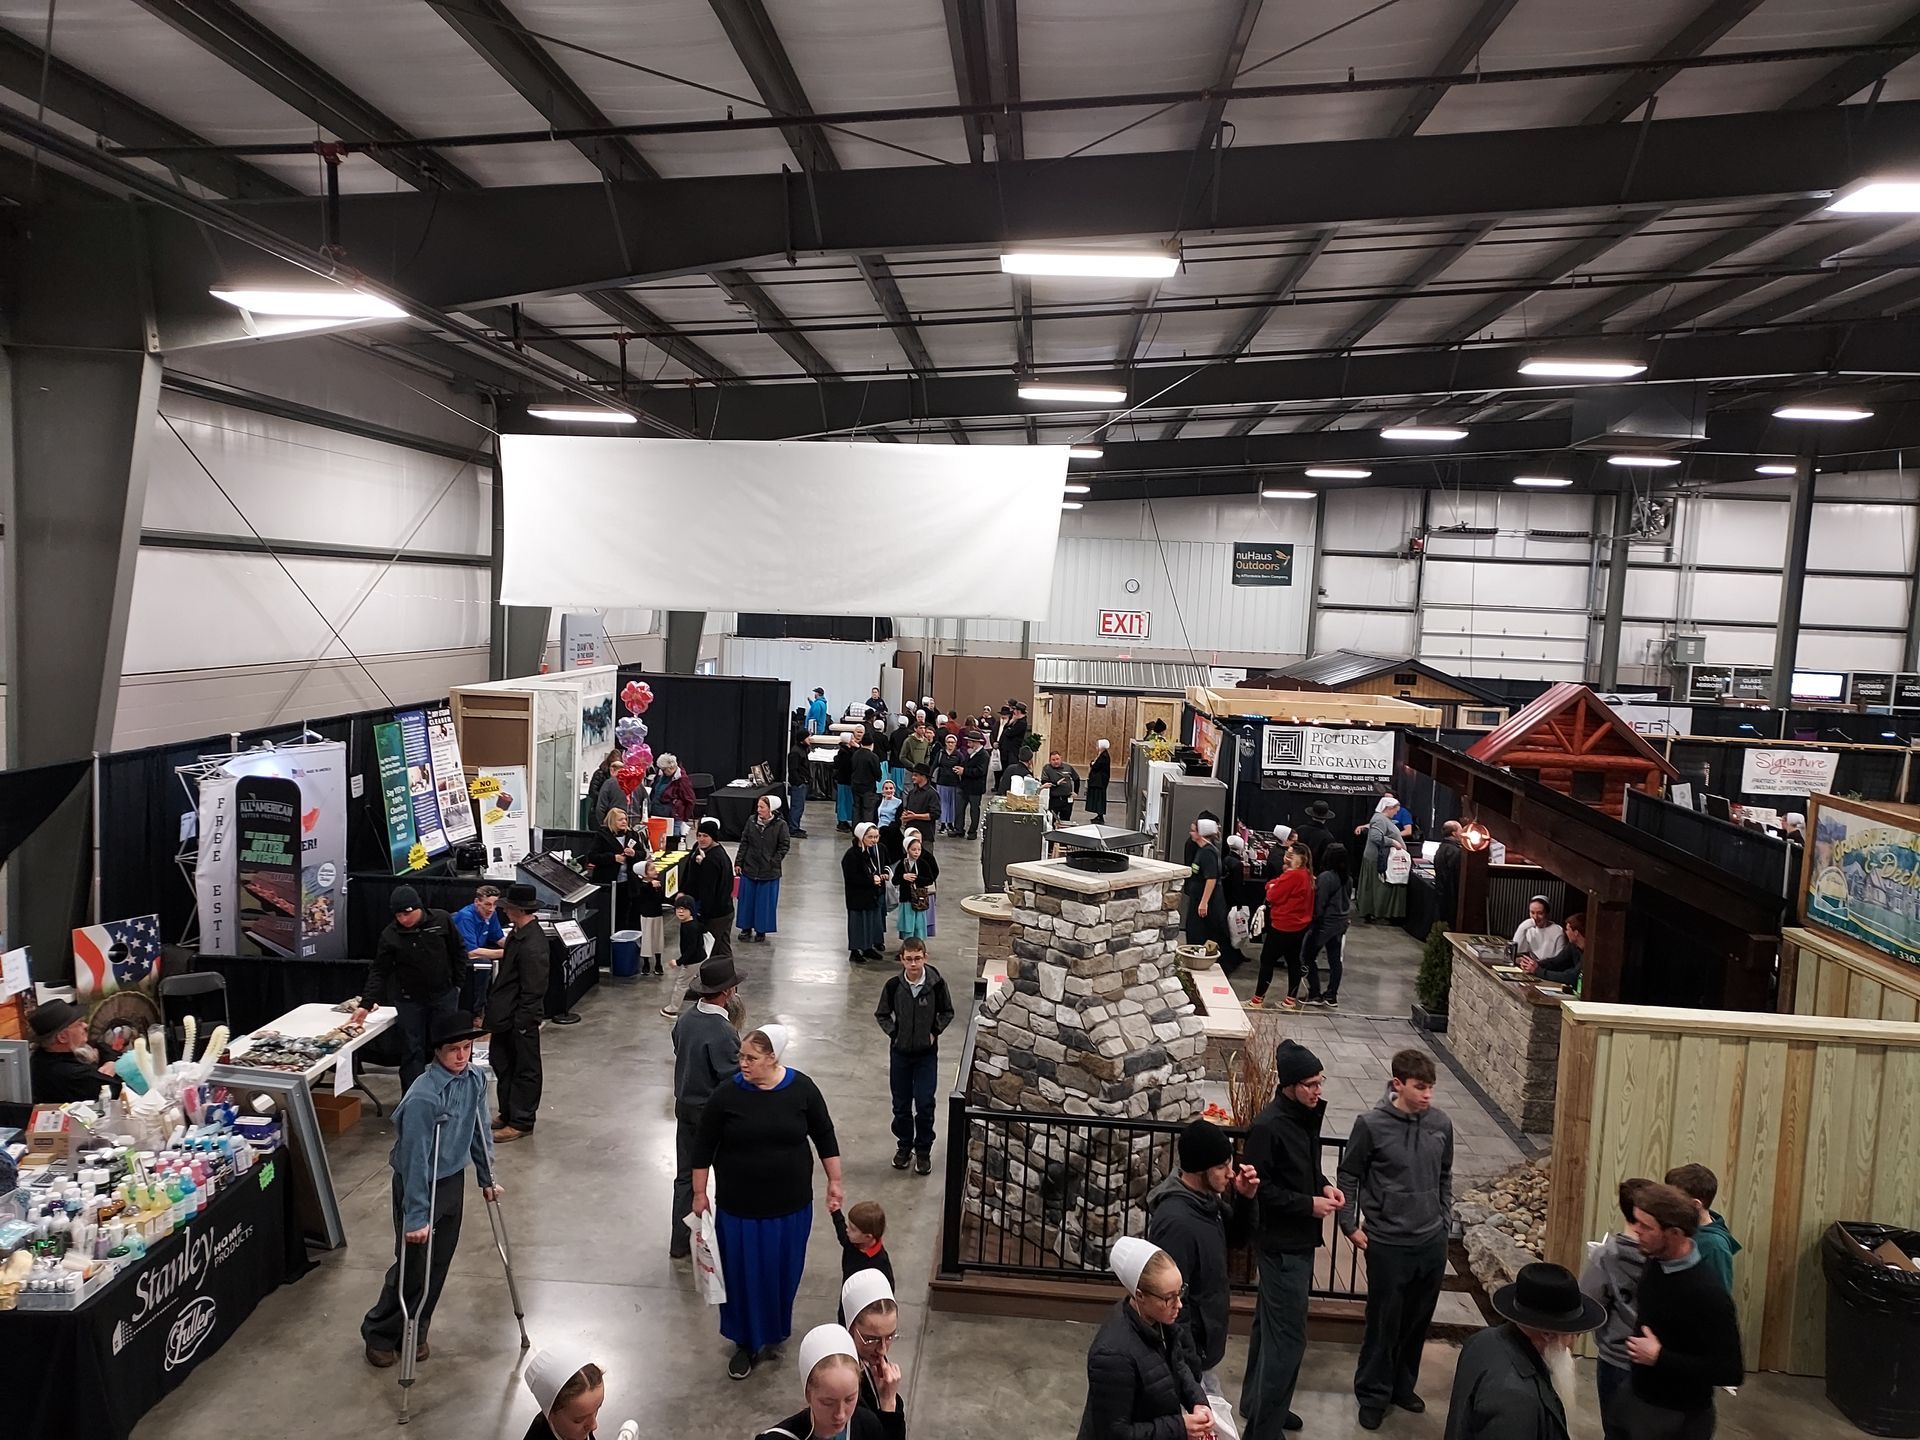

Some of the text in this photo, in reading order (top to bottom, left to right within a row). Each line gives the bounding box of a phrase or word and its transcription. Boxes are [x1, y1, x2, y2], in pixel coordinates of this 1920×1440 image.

[1236, 551, 1273, 560] nuHaus
[1235, 561, 1280, 570] Outdoors
[1102, 613, 1144, 634] EXIT
[1311, 744, 1323, 754] IT
[1309, 756, 1387, 770] ENGRAVING
[1755, 752, 1827, 776] Signature
[472, 785, 500, 795] CHEMICALS
[480, 780, 491, 788] NO
[1278, 779, 1299, 790] You
[1299, 781, 1322, 789] picture
[1341, 785, 1367, 795] engrave
[256, 802, 294, 817] AMERICAN
[213, 1222, 243, 1254] HOME
[214, 1225, 254, 1268] PRODUCTS
[131, 1225, 214, 1322] Stanley
[169, 1303, 214, 1362] Fuller
